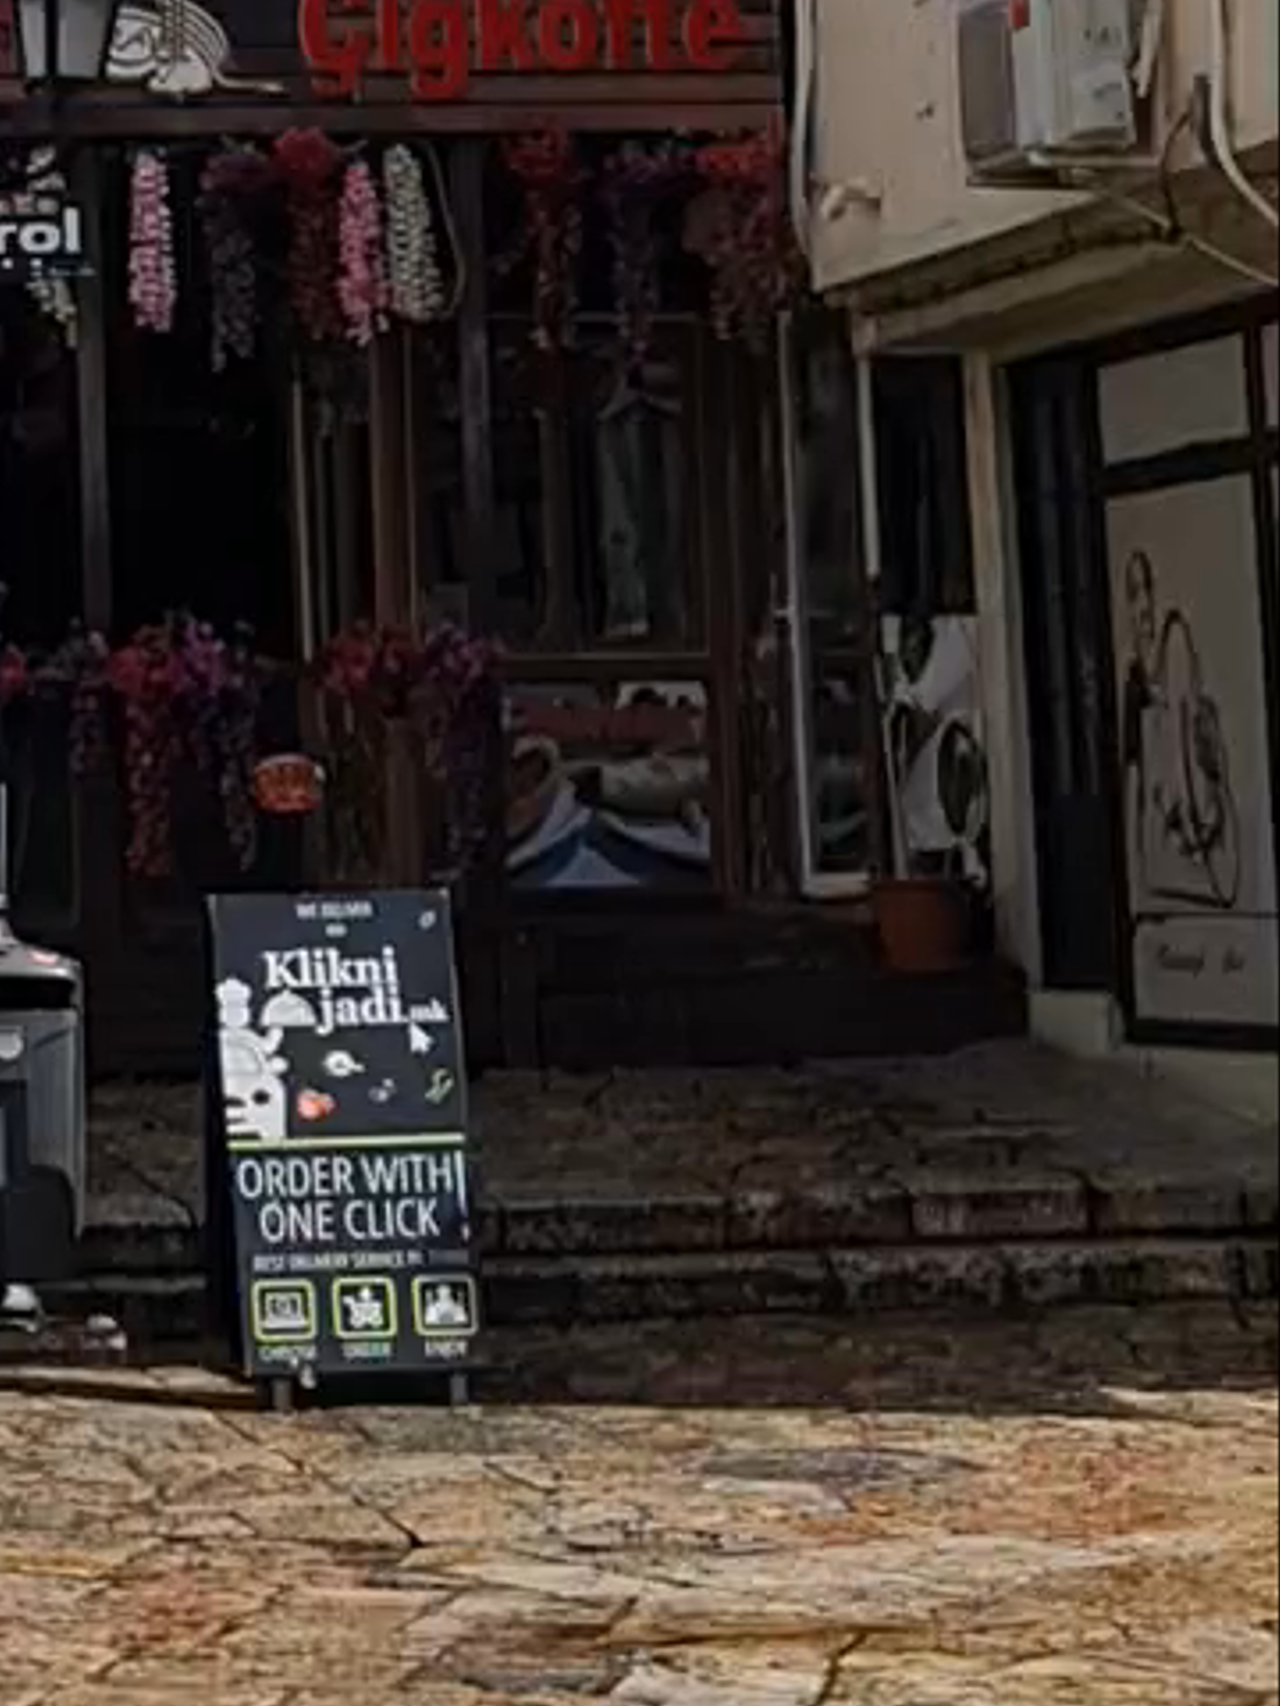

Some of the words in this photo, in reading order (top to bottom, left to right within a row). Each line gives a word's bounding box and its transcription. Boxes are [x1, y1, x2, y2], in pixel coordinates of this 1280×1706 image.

[262, 945, 399, 989] Klikni
[237, 1156, 356, 1199] ORDER
[359, 1151, 452, 1194] WITH
[259, 1199, 336, 1244] ONE
[343, 1197, 441, 1241] CLICK
